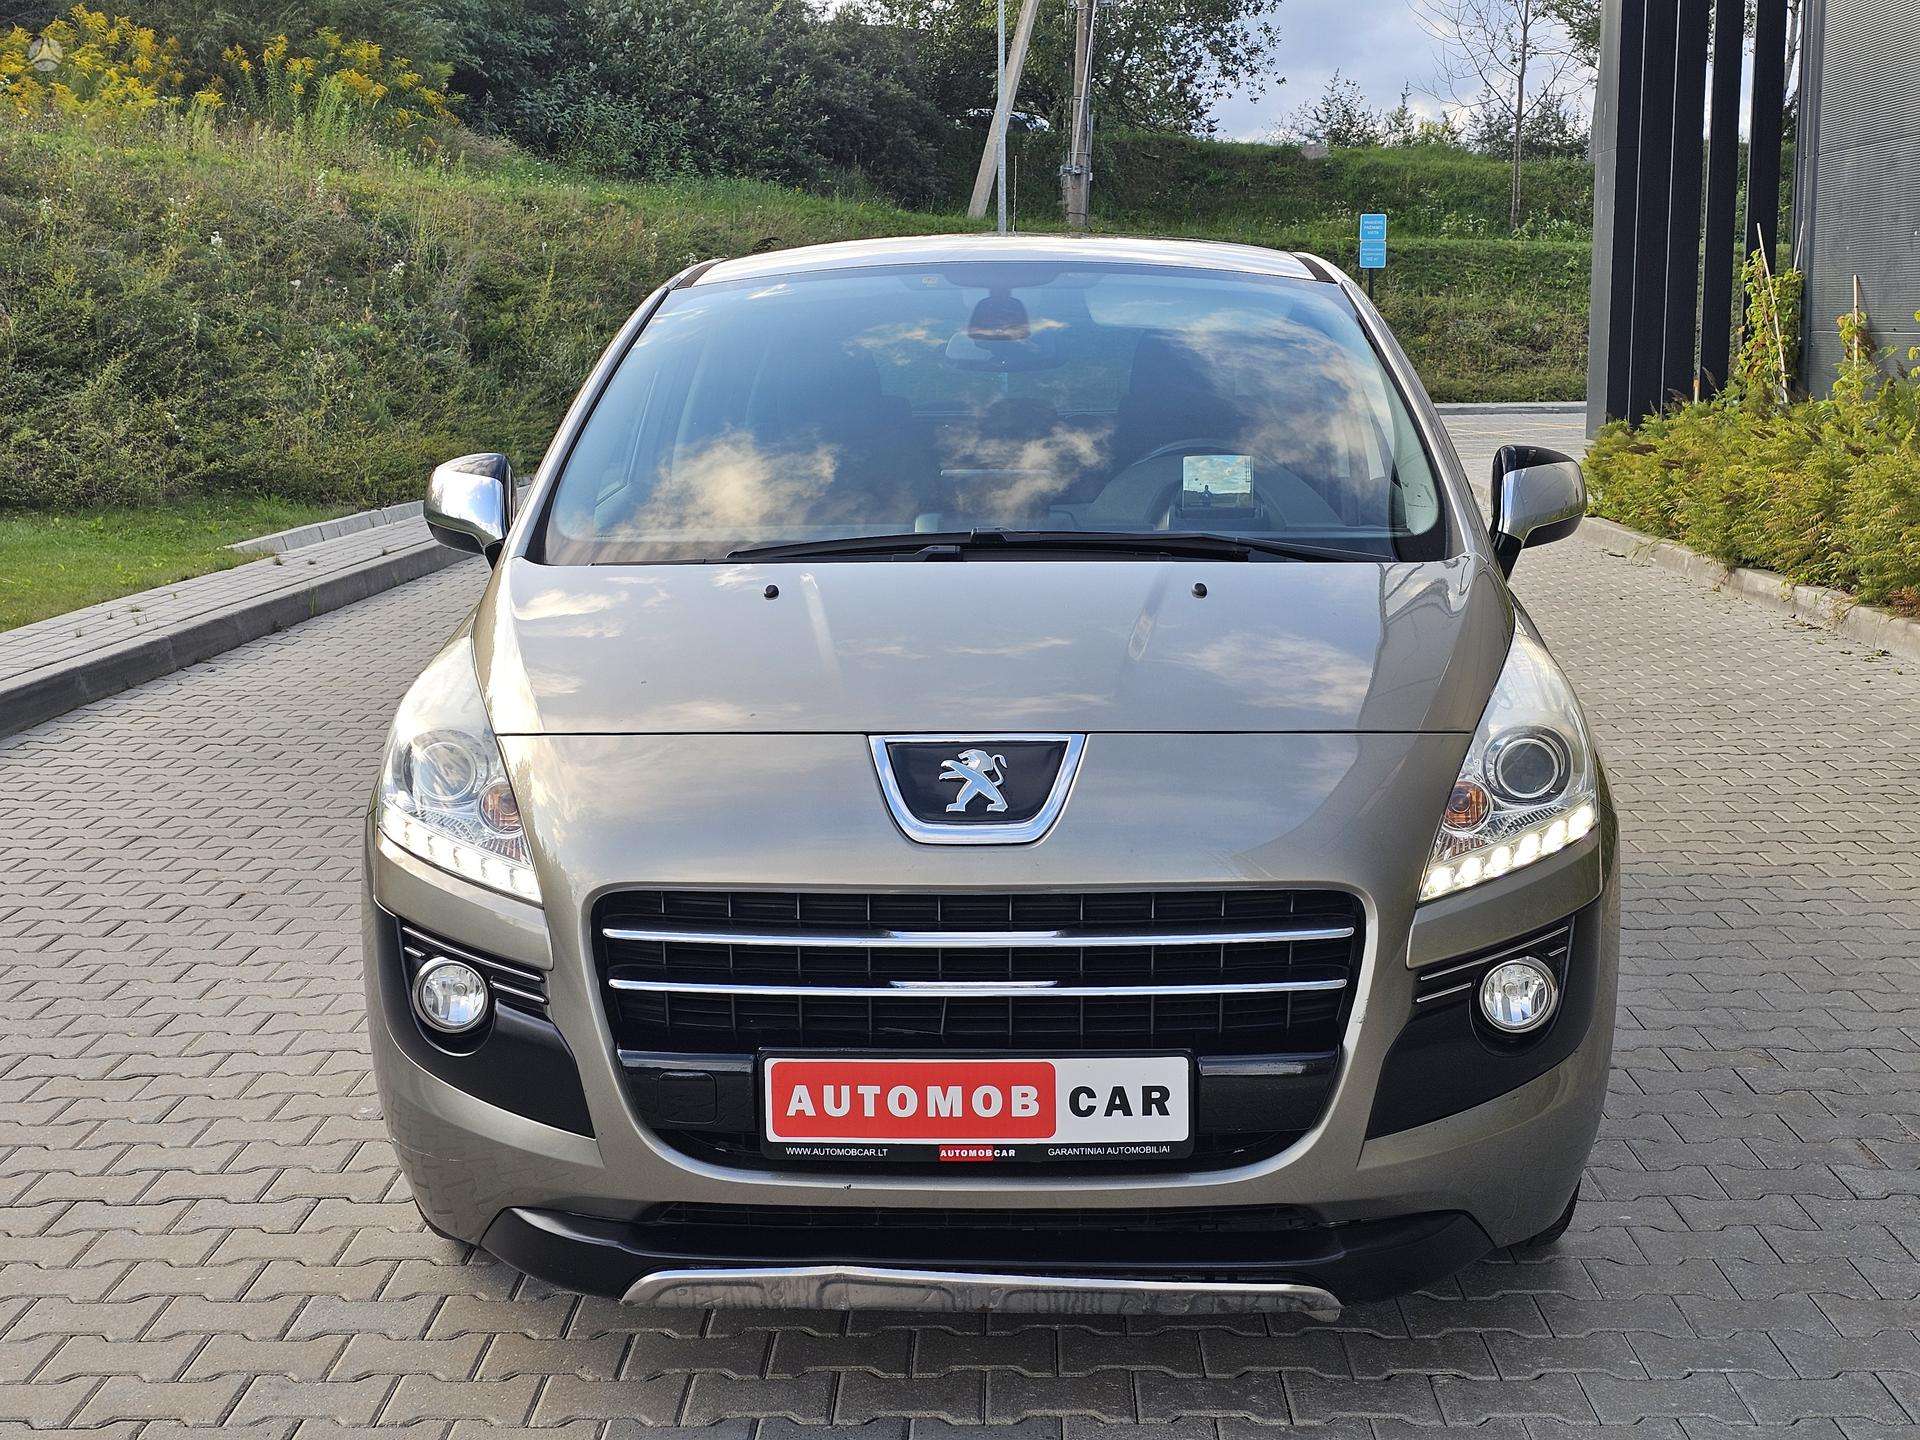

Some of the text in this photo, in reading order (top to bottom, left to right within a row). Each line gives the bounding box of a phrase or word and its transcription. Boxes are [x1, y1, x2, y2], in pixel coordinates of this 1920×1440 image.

[786, 1085, 1171, 1117] AUTOMOB CAR
[786, 1147, 888, 1157] WWW.AUTOMOBCAR.LT
[1048, 1145, 1170, 1156] GARANTINIAI AUTOMOBILIAI
